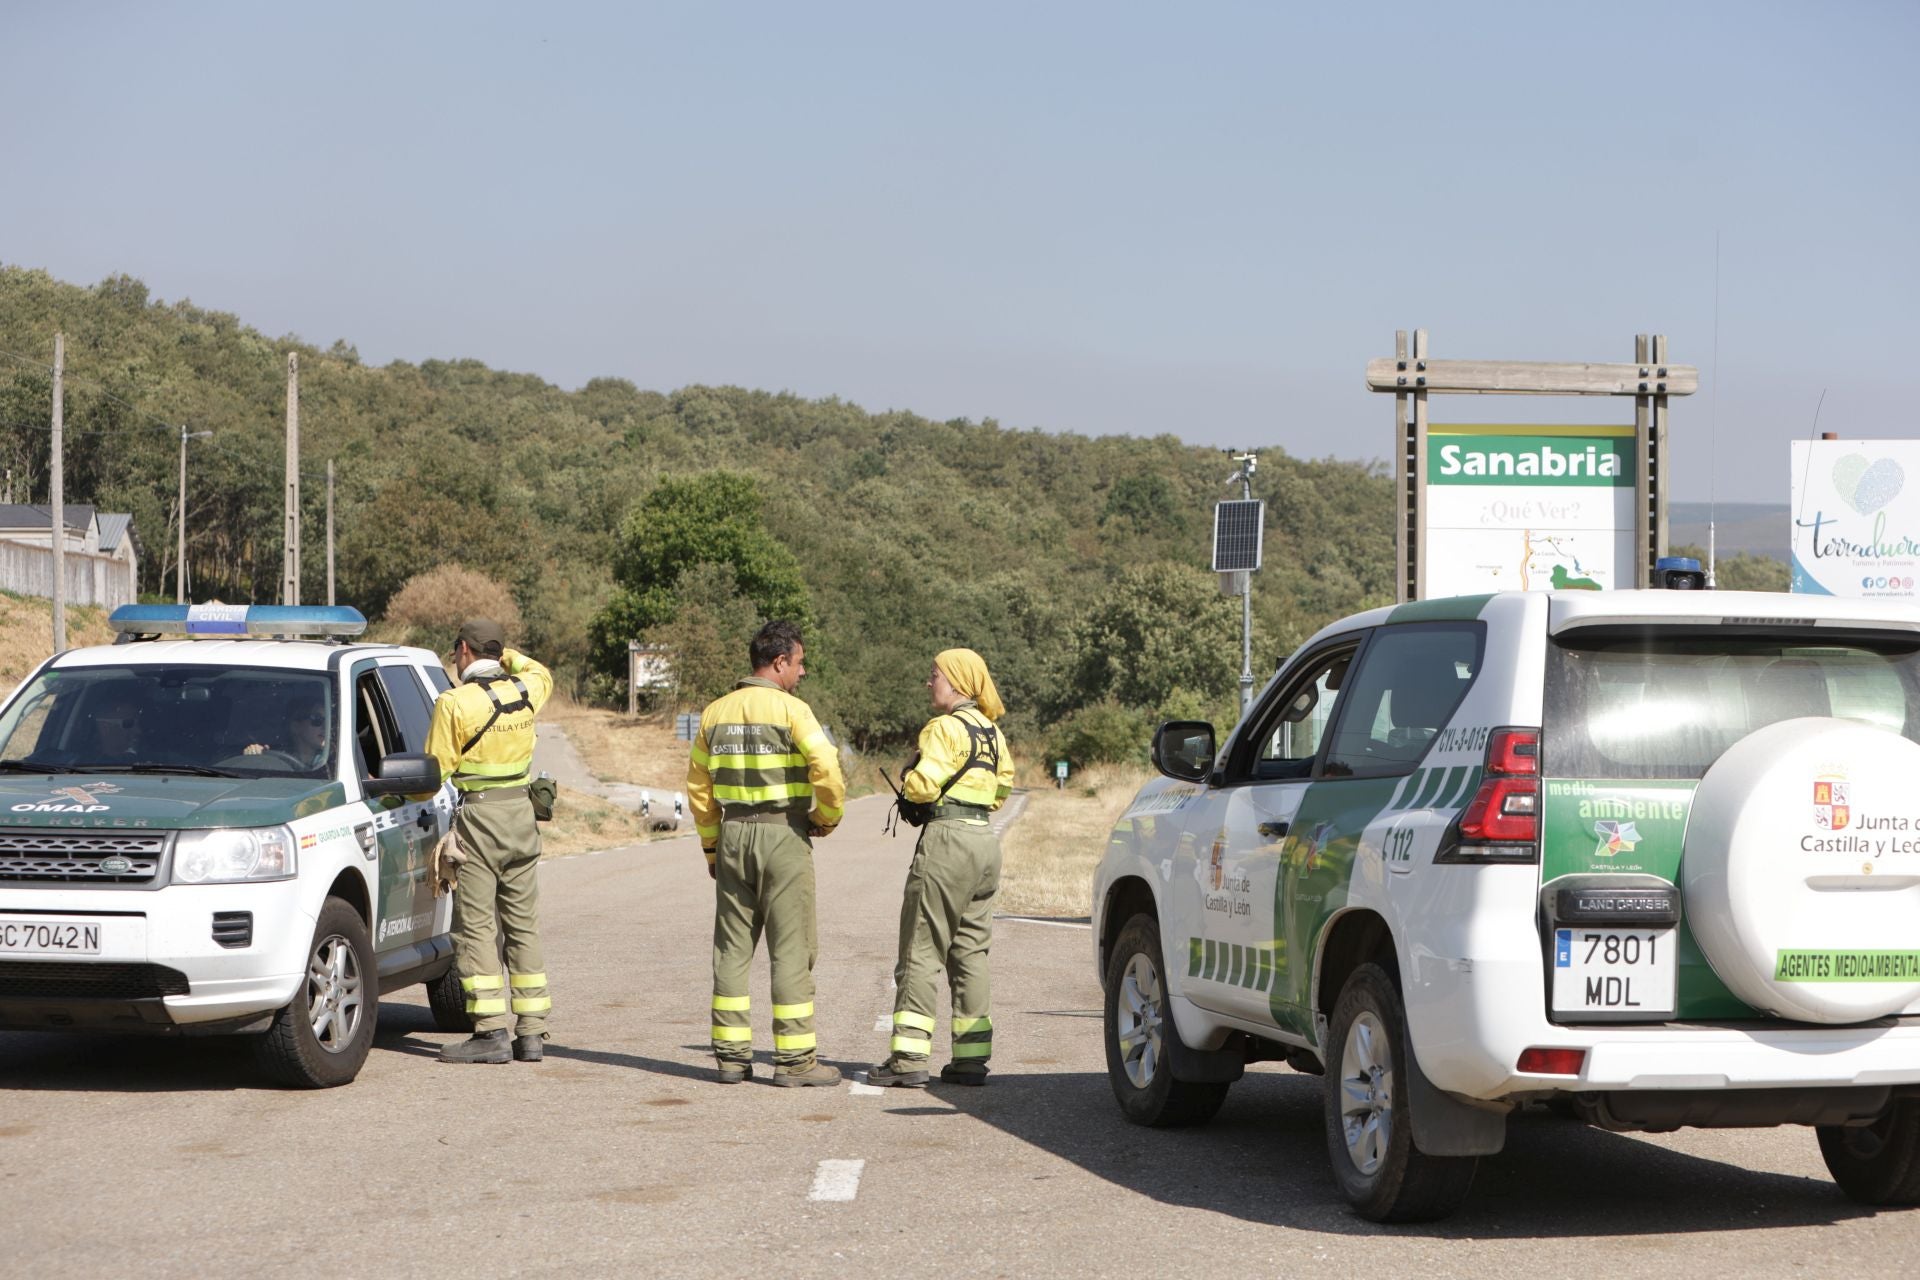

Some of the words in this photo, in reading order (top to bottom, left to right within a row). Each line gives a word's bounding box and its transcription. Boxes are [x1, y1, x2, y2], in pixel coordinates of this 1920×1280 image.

[1440, 444, 1621, 477] Sanabria
[1480, 500, 1532, 524] ¿Qué
[1536, 501, 1581, 520] Ver?
[200, 612, 233, 621] CIVIL
[475, 724, 513, 734] CSTILLA
[726, 725, 751, 736] JUNTA
[751, 725, 762, 735] DE
[1438, 727, 1489, 753] CYL-3-015
[712, 743, 749, 755] CASTILLA
[1549, 781, 1596, 796] medio
[11, 803, 111, 813] OMAP
[1579, 796, 1683, 820] ambiente
[1856, 814, 1909, 831] Junta
[1391, 828, 1414, 861] 112
[1800, 835, 1870, 853] Castilla
[1874, 839, 1886, 858] y
[1892, 836, 1920, 853] Leó
[1222, 874, 1240, 892] Junta
[1241, 875, 1251, 893] de
[1205, 893, 1228, 913] Castilla
[1234, 898, 1251, 916] León
[1579, 899, 1613, 910] LAND
[1616, 899, 1670, 910] CRUISER
[23, 925, 79, 949] 7042
[84, 926, 98, 950] N
[1560, 952, 1567, 961] E
[1584, 934, 1656, 965] 7801
[1780, 954, 1831, 977] AGENTES
[1834, 954, 1920, 977] MEDIOAMBIENTA
[1585, 976, 1641, 1006] MDL
